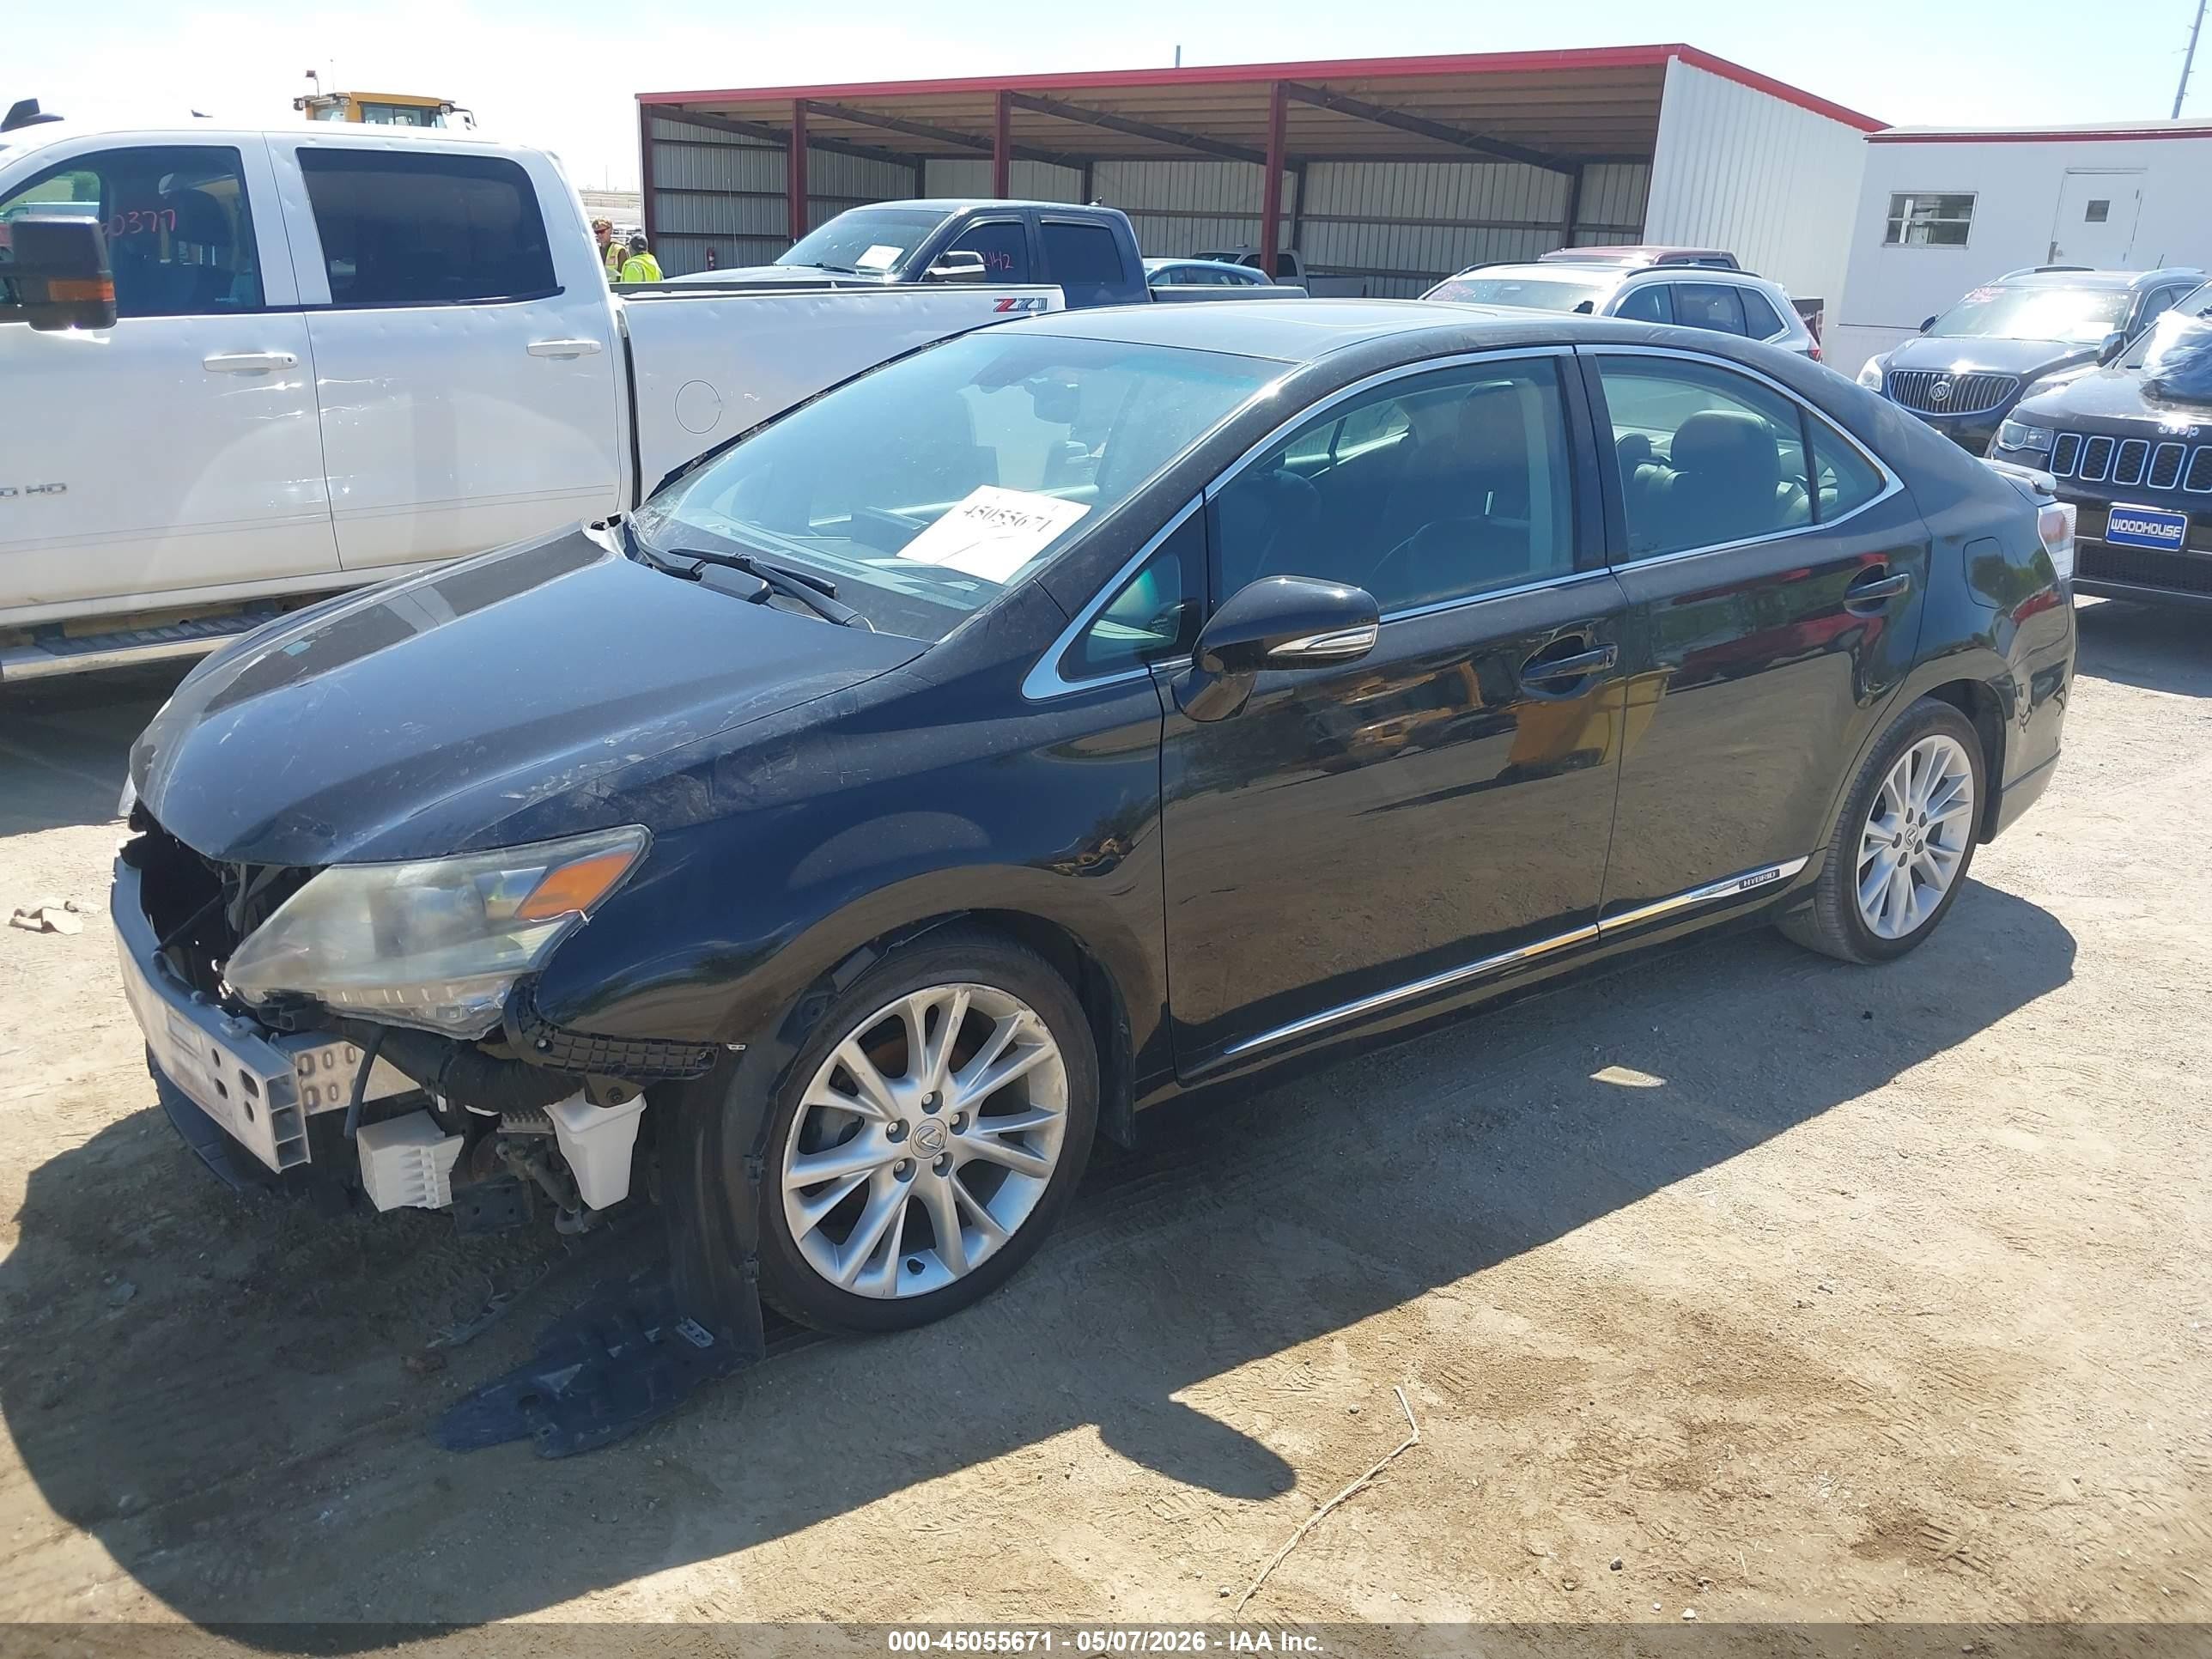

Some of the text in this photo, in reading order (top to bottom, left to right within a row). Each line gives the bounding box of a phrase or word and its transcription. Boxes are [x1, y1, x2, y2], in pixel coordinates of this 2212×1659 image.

[993, 297, 1048, 313] Z71
[26, 483, 67, 495] HD
[2110, 518, 2183, 538] WOODHOUSE
[1743, 871, 1777, 887] HYBRID
